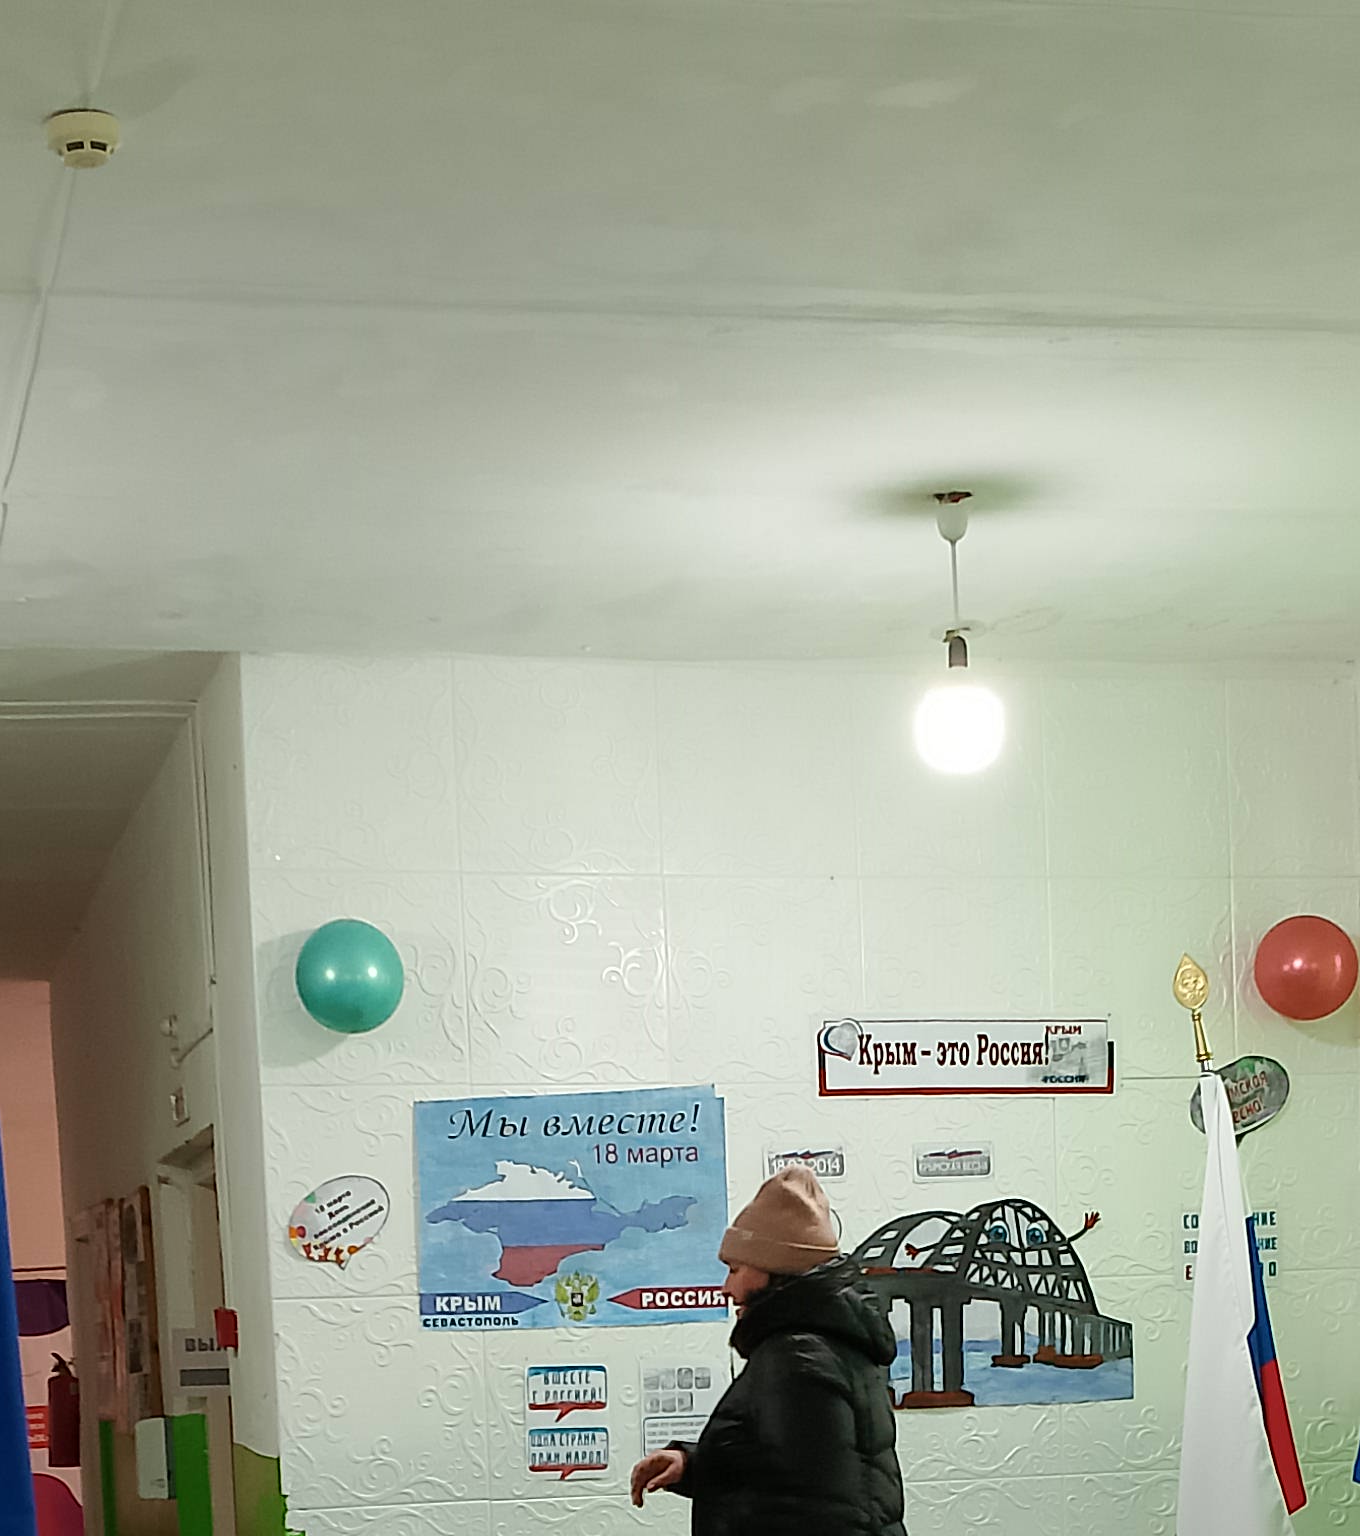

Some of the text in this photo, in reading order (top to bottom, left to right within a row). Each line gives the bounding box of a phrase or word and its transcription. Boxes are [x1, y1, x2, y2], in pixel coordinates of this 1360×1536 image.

[857, 1034, 917, 1074] Крым
[937, 1041, 969, 1066] это
[976, 1031, 1049, 1066] Россия!
[447, 1103, 701, 1140] Мы вместе!
[592, 1143, 699, 1168] 18 марта
[435, 1288, 726, 1313] КРЫМ РОССИЯ
[422, 1315, 520, 1328] СЕВАСТОПОЛЬ
